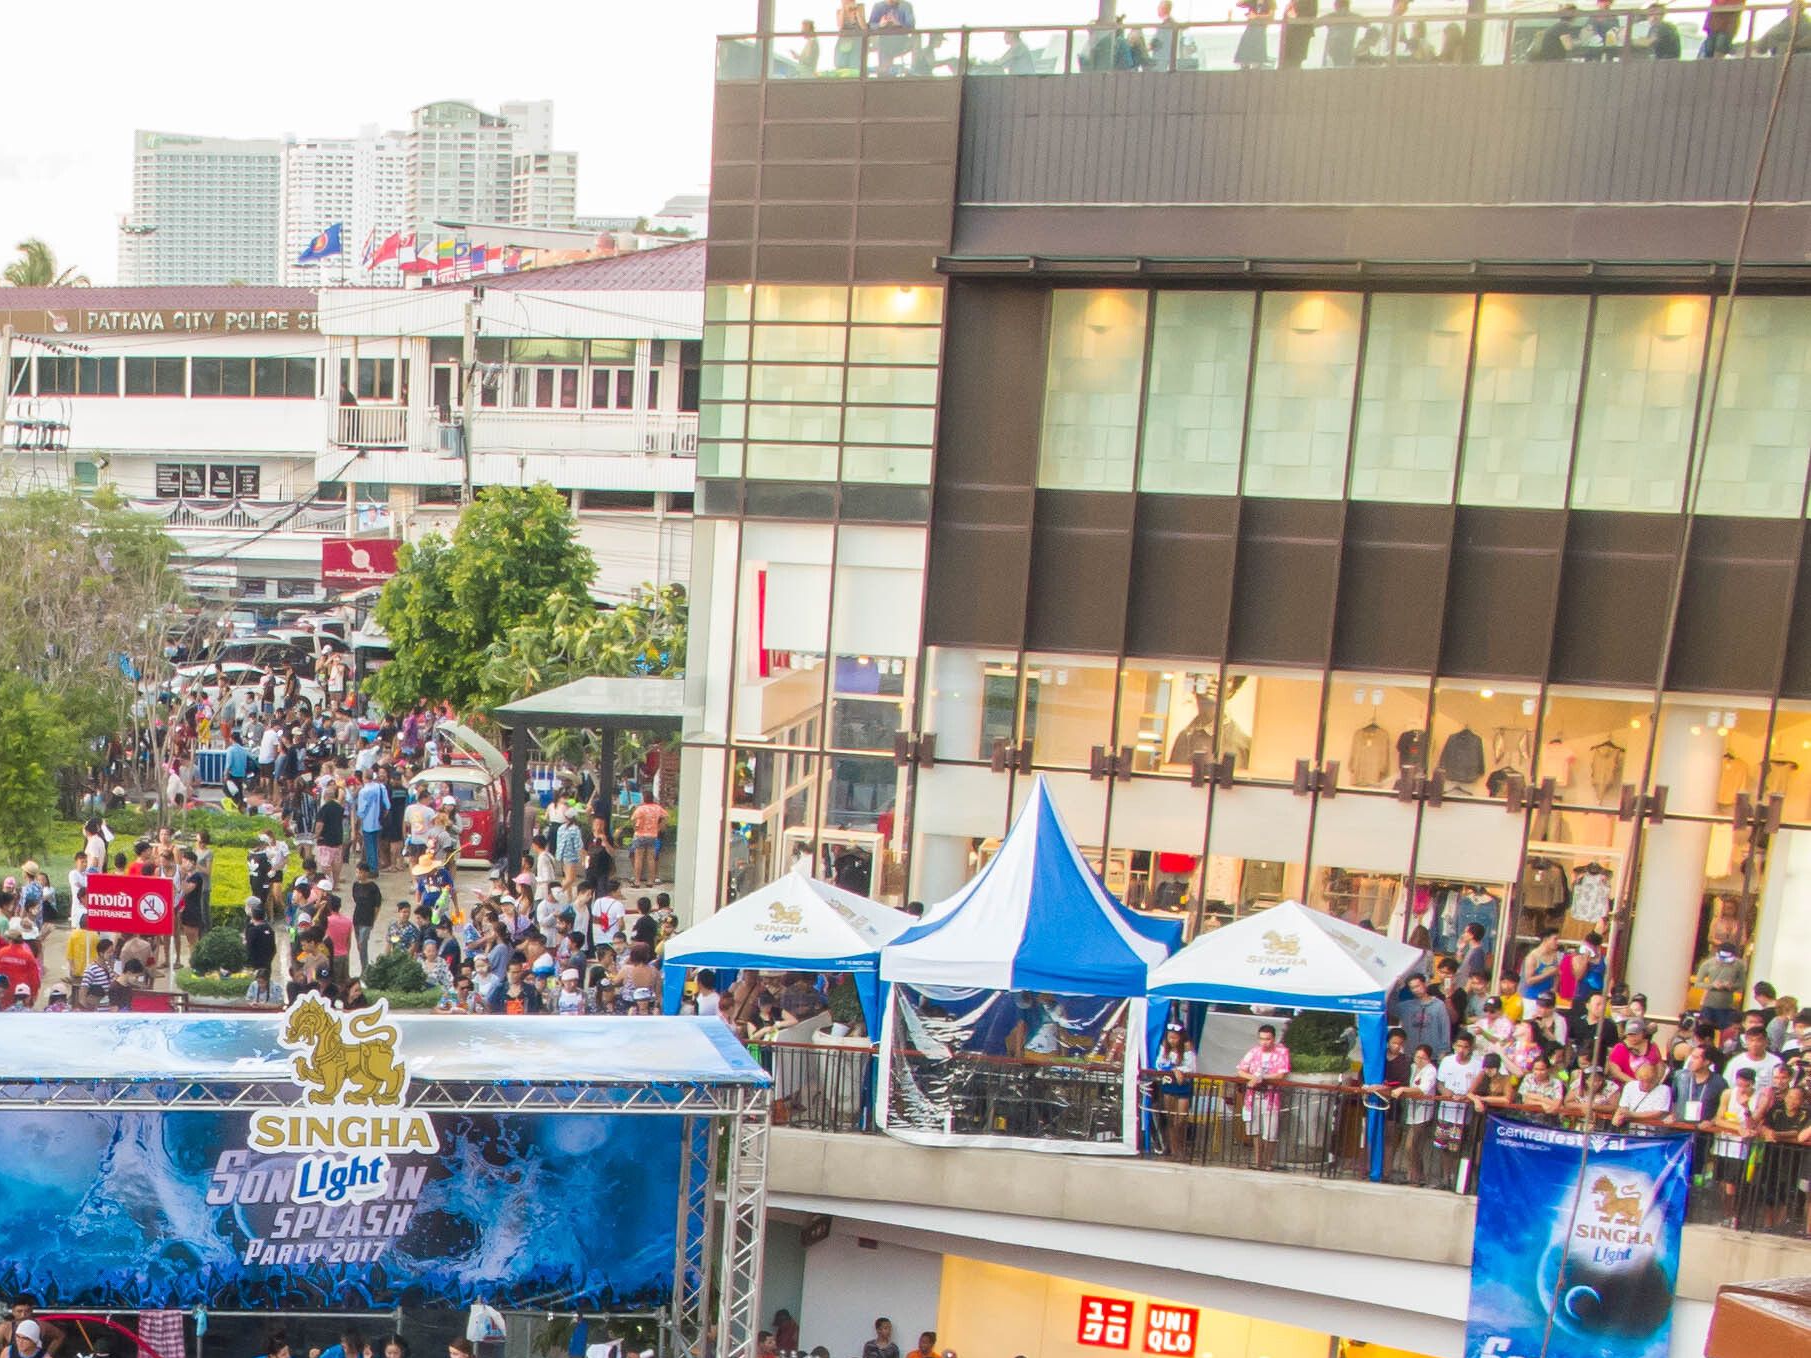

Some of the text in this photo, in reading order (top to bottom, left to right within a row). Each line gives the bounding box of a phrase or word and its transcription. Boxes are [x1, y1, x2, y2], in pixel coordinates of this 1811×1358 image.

[88, 311, 164, 330] PATTAYA
[173, 311, 215, 330] CITY
[225, 311, 289, 330] POLICE
[88, 891, 133, 908] ทางเข้า
[88, 908, 133, 919] ENTRANCE
[254, 1115, 433, 1148] SINGHA
[297, 1154, 385, 1202] Light
[270, 1203, 414, 1240] SPLASH
[1575, 1223, 1654, 1246] SINGHA
[242, 1237, 387, 1266] PARTY 2017
[1593, 1245, 1633, 1266] Light
[1149, 1309, 1191, 1332] UNI
[1148, 1329, 1192, 1352] QLO
